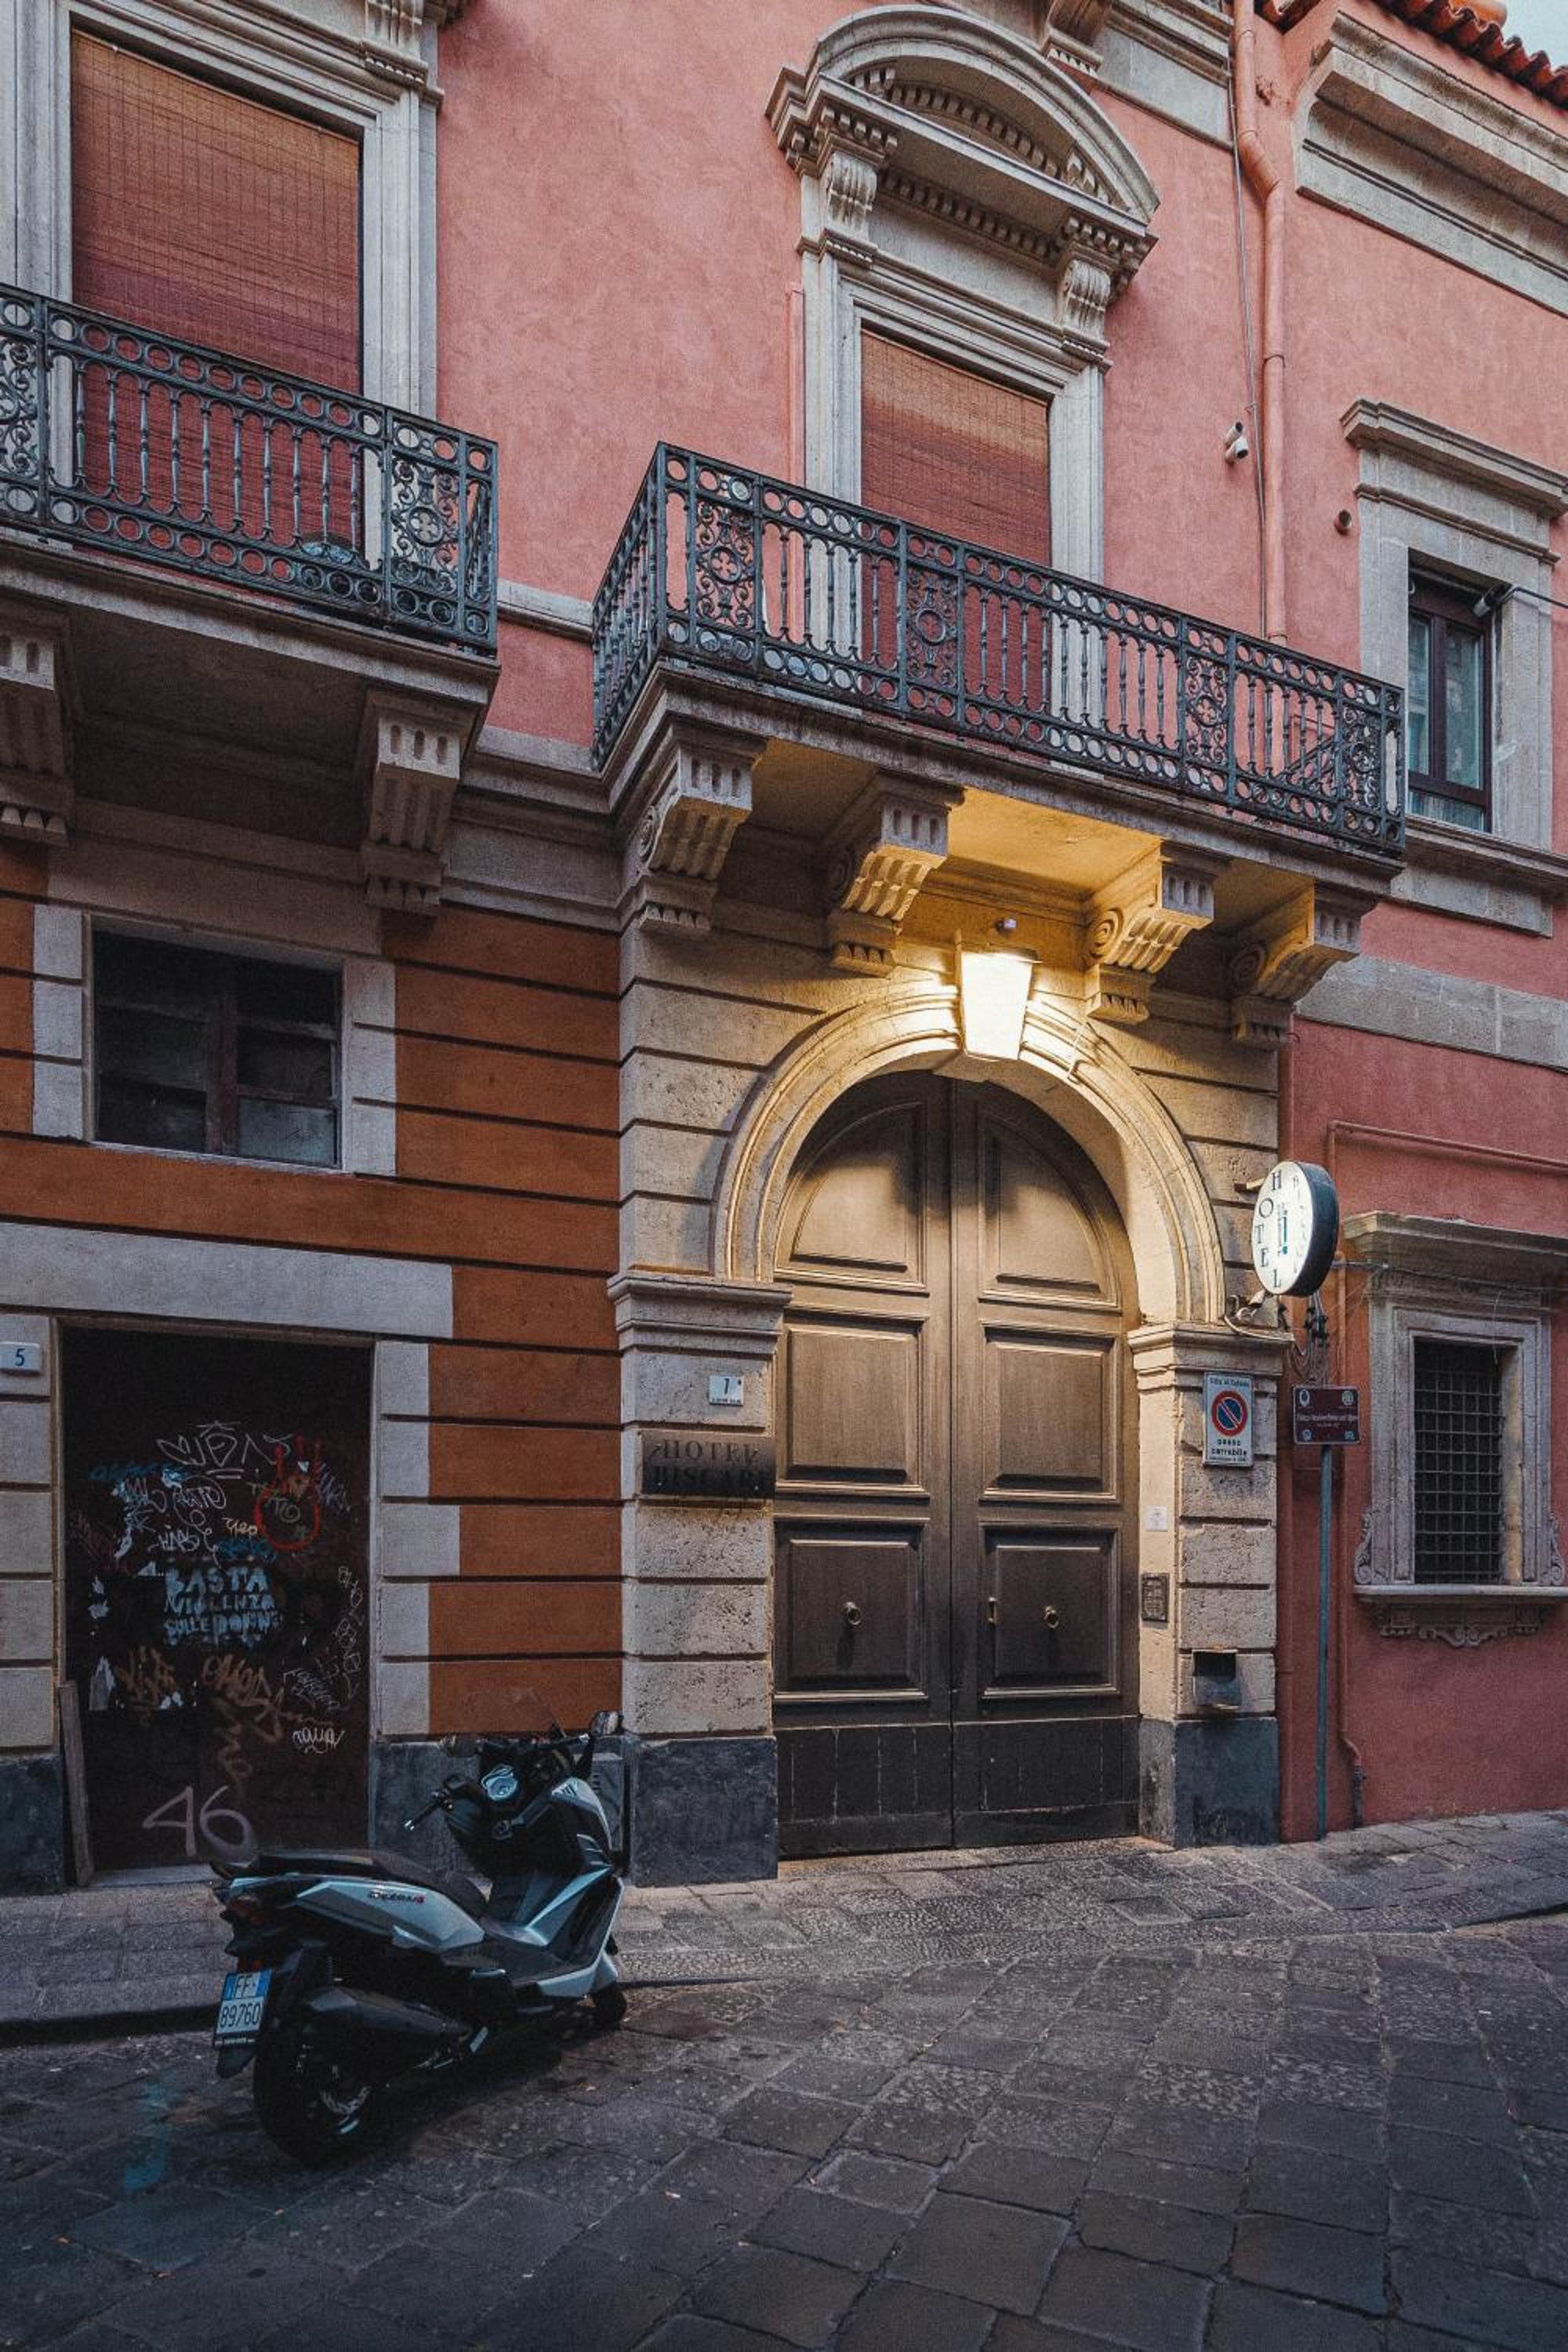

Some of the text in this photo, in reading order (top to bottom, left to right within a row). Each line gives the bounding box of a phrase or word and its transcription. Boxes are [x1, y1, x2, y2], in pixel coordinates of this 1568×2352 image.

[1254, 1170, 1282, 1289] HOTEL
[15, 1348, 26, 1367] 5
[663, 1439, 754, 1461] HOTEL
[164, 1566, 270, 1595] BASTA
[164, 1592, 275, 1615] VIOLENZA
[142, 1785, 253, 1862] 46
[234, 1974, 253, 1998] FF
[219, 2002, 261, 2029] 89760
